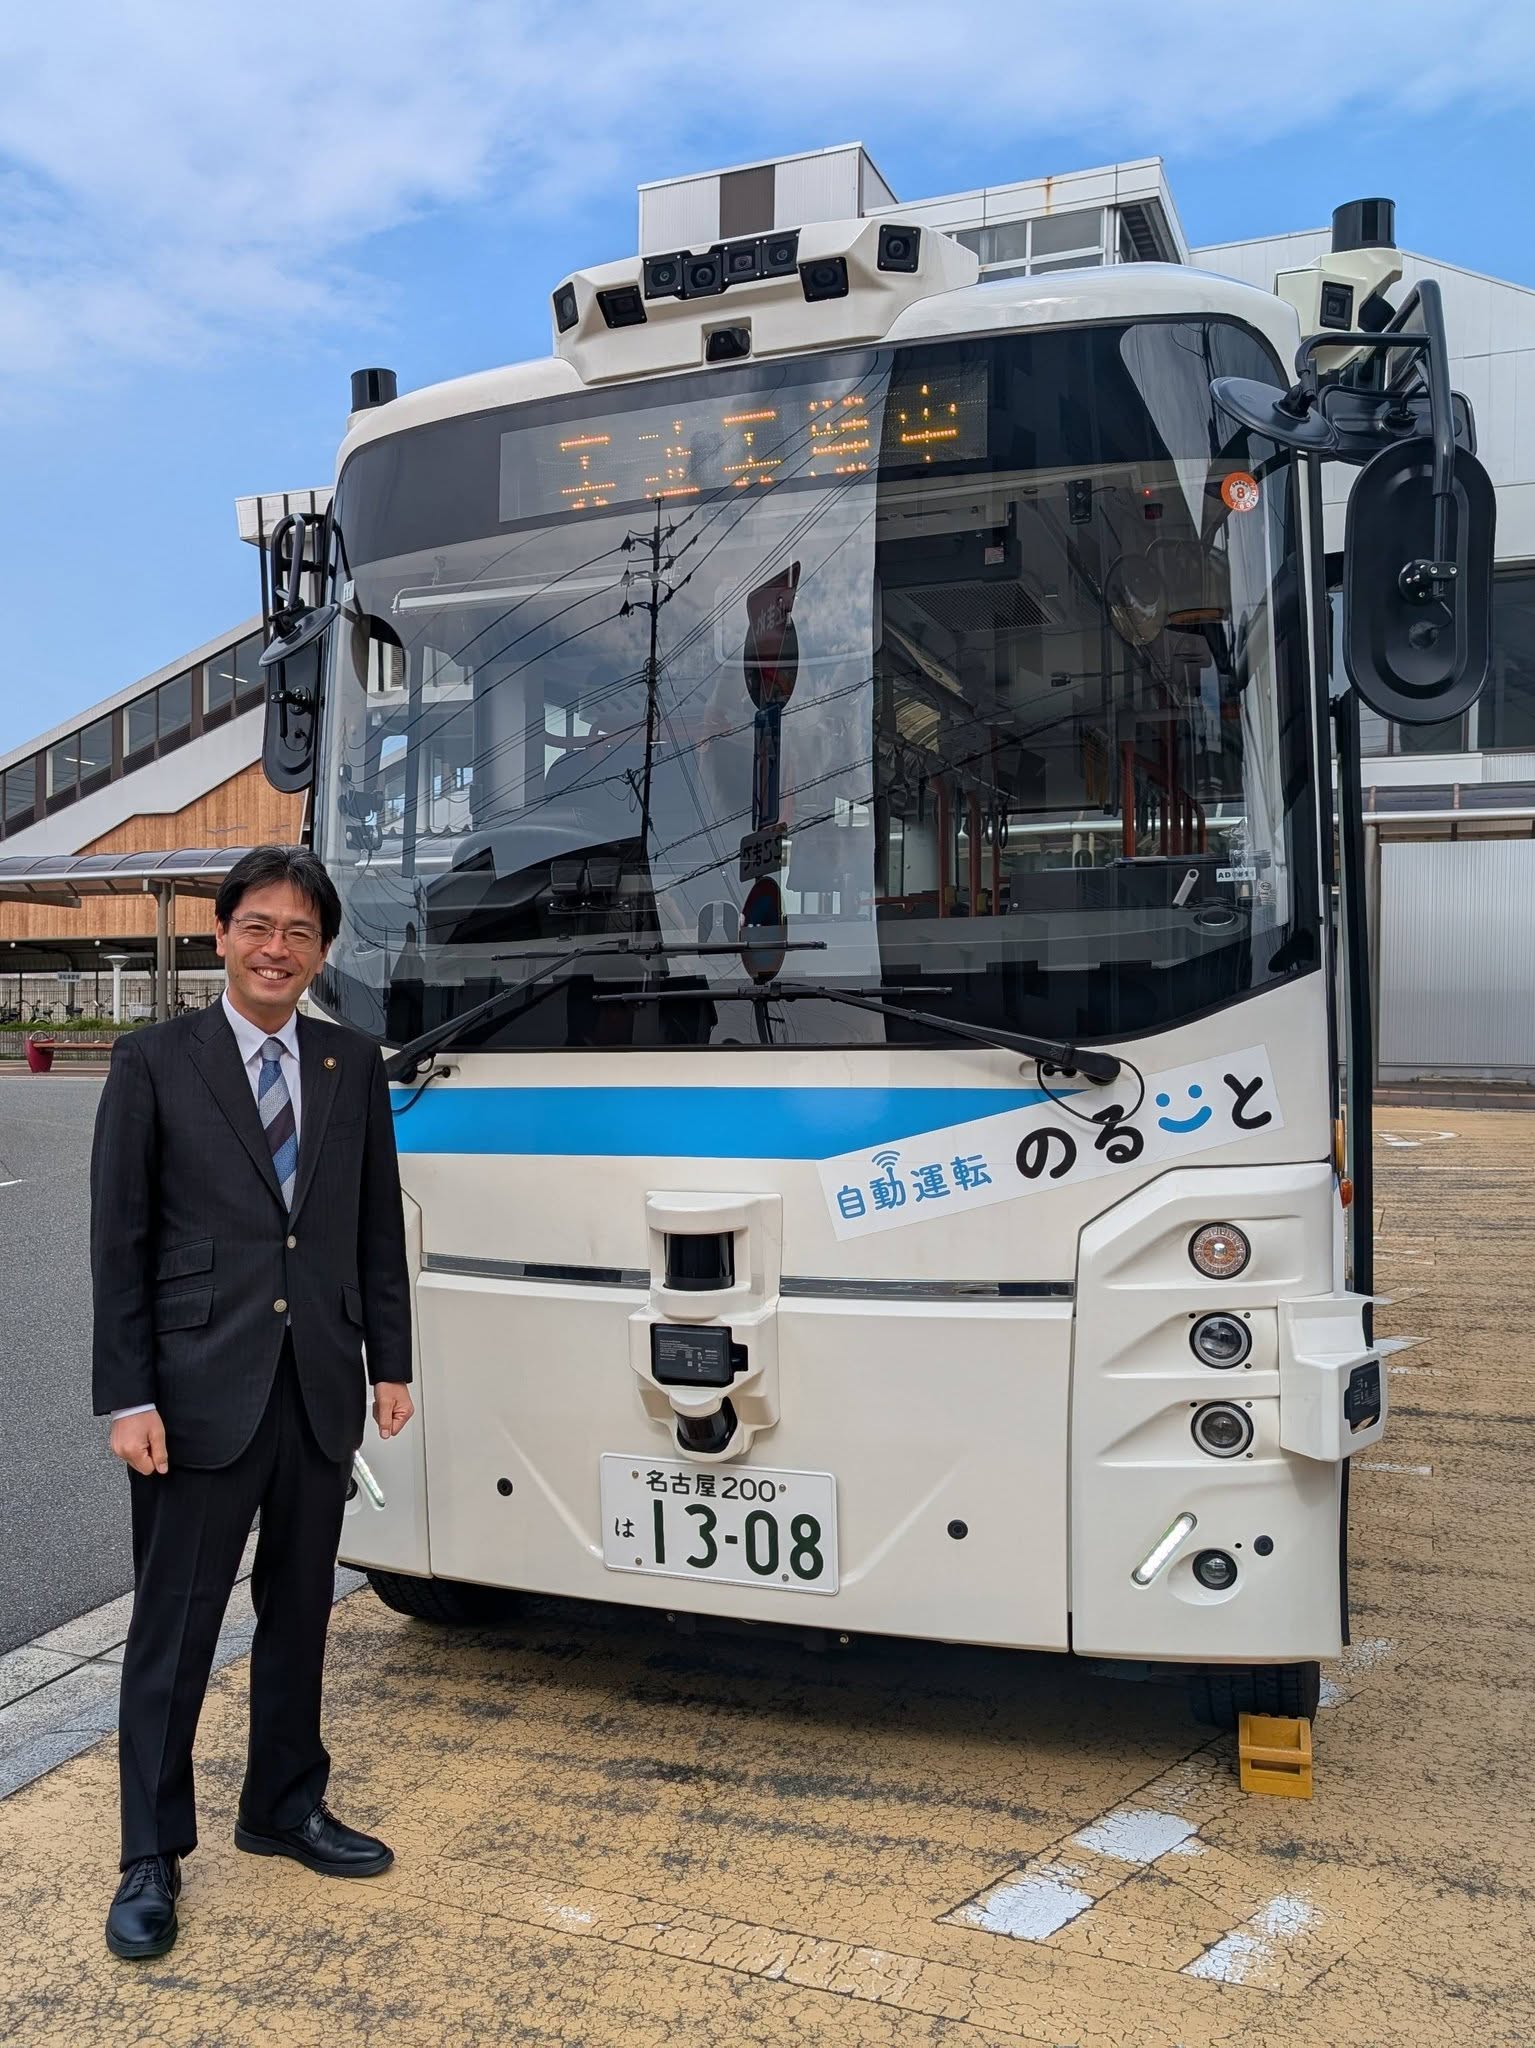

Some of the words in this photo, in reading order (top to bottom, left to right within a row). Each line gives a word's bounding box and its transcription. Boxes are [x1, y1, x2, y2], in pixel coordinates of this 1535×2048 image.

[837, 1154, 993, 1220] 自動運転
[614, 1516, 636, 1539] は
[653, 1499, 824, 1581] 13-08
